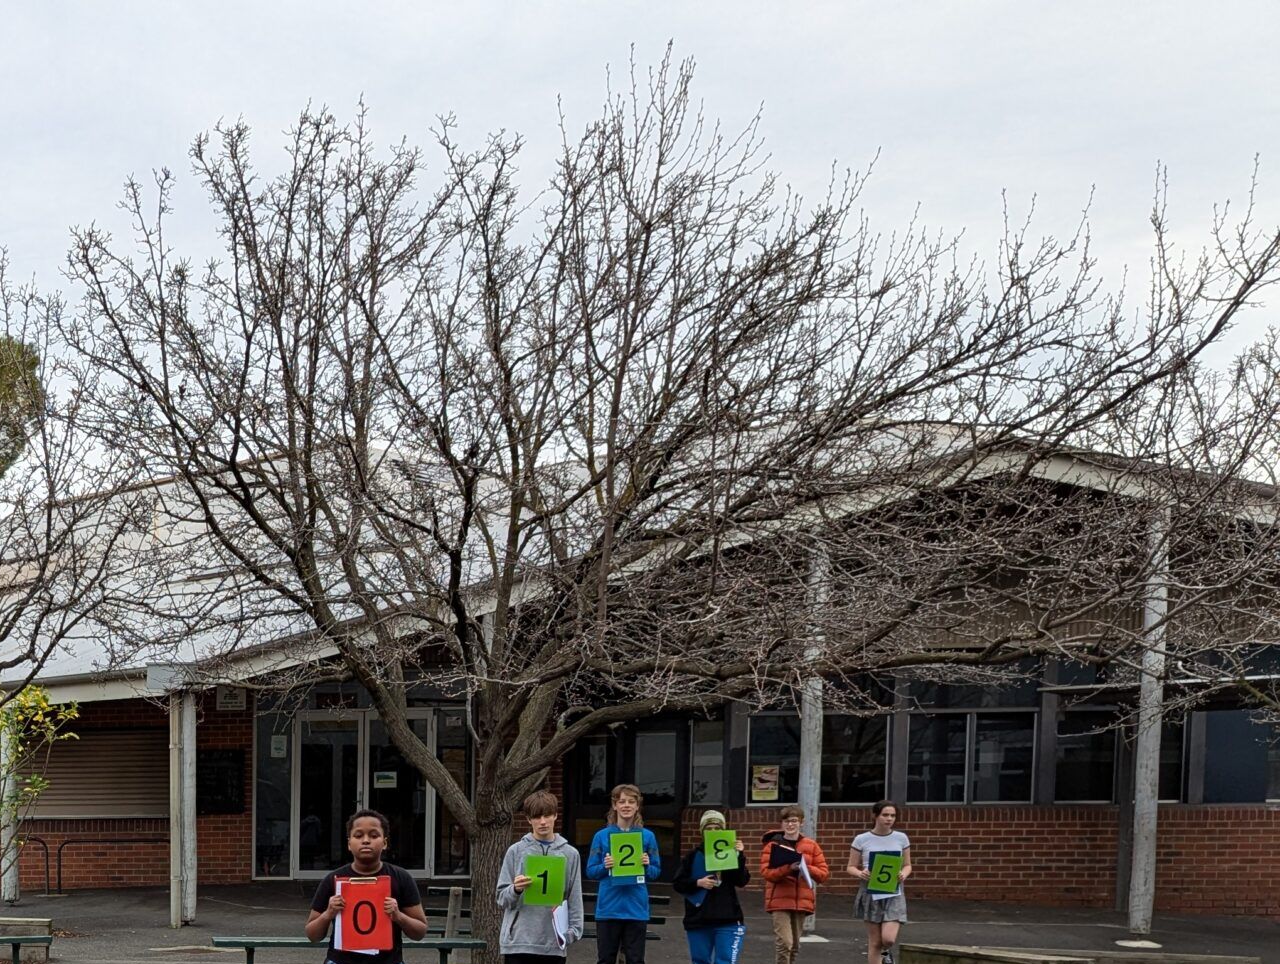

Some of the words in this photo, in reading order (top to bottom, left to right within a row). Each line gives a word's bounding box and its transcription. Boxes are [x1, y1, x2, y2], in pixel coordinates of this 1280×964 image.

[618, 844, 636, 867] 2
[713, 839, 729, 860] 3
[537, 870, 548, 895] 1
[877, 864, 893, 883] 5
[352, 900, 377, 935] 0
